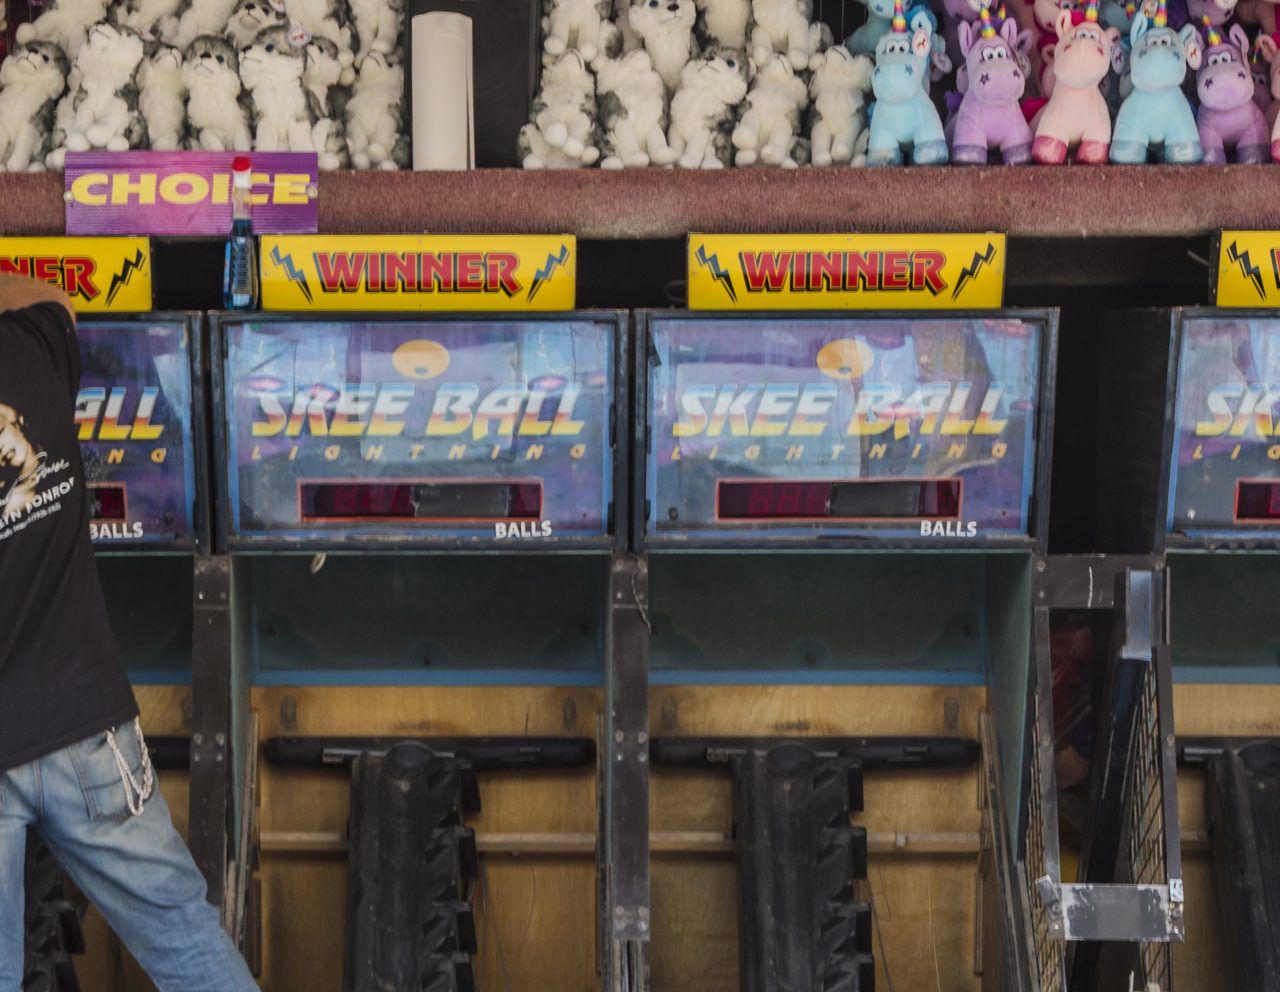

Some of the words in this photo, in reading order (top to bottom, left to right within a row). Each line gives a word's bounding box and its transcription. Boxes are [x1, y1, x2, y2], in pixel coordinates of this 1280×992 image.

[313, 251, 523, 297] WINNER
[739, 250, 948, 295] WINNER
[74, 387, 164, 440] ALL
[251, 382, 416, 436] SKEE
[425, 382, 585, 441] BALL
[673, 382, 838, 437] SKEE
[848, 381, 1009, 440] BALL
[1196, 383, 1280, 436] SK
[251, 444, 586, 460] LIGHTNING
[671, 443, 1007, 460] LIGHTNING
[89, 522, 143, 540] BALLS
[495, 520, 552, 539] BALLS
[921, 520, 977, 537] BALLS
